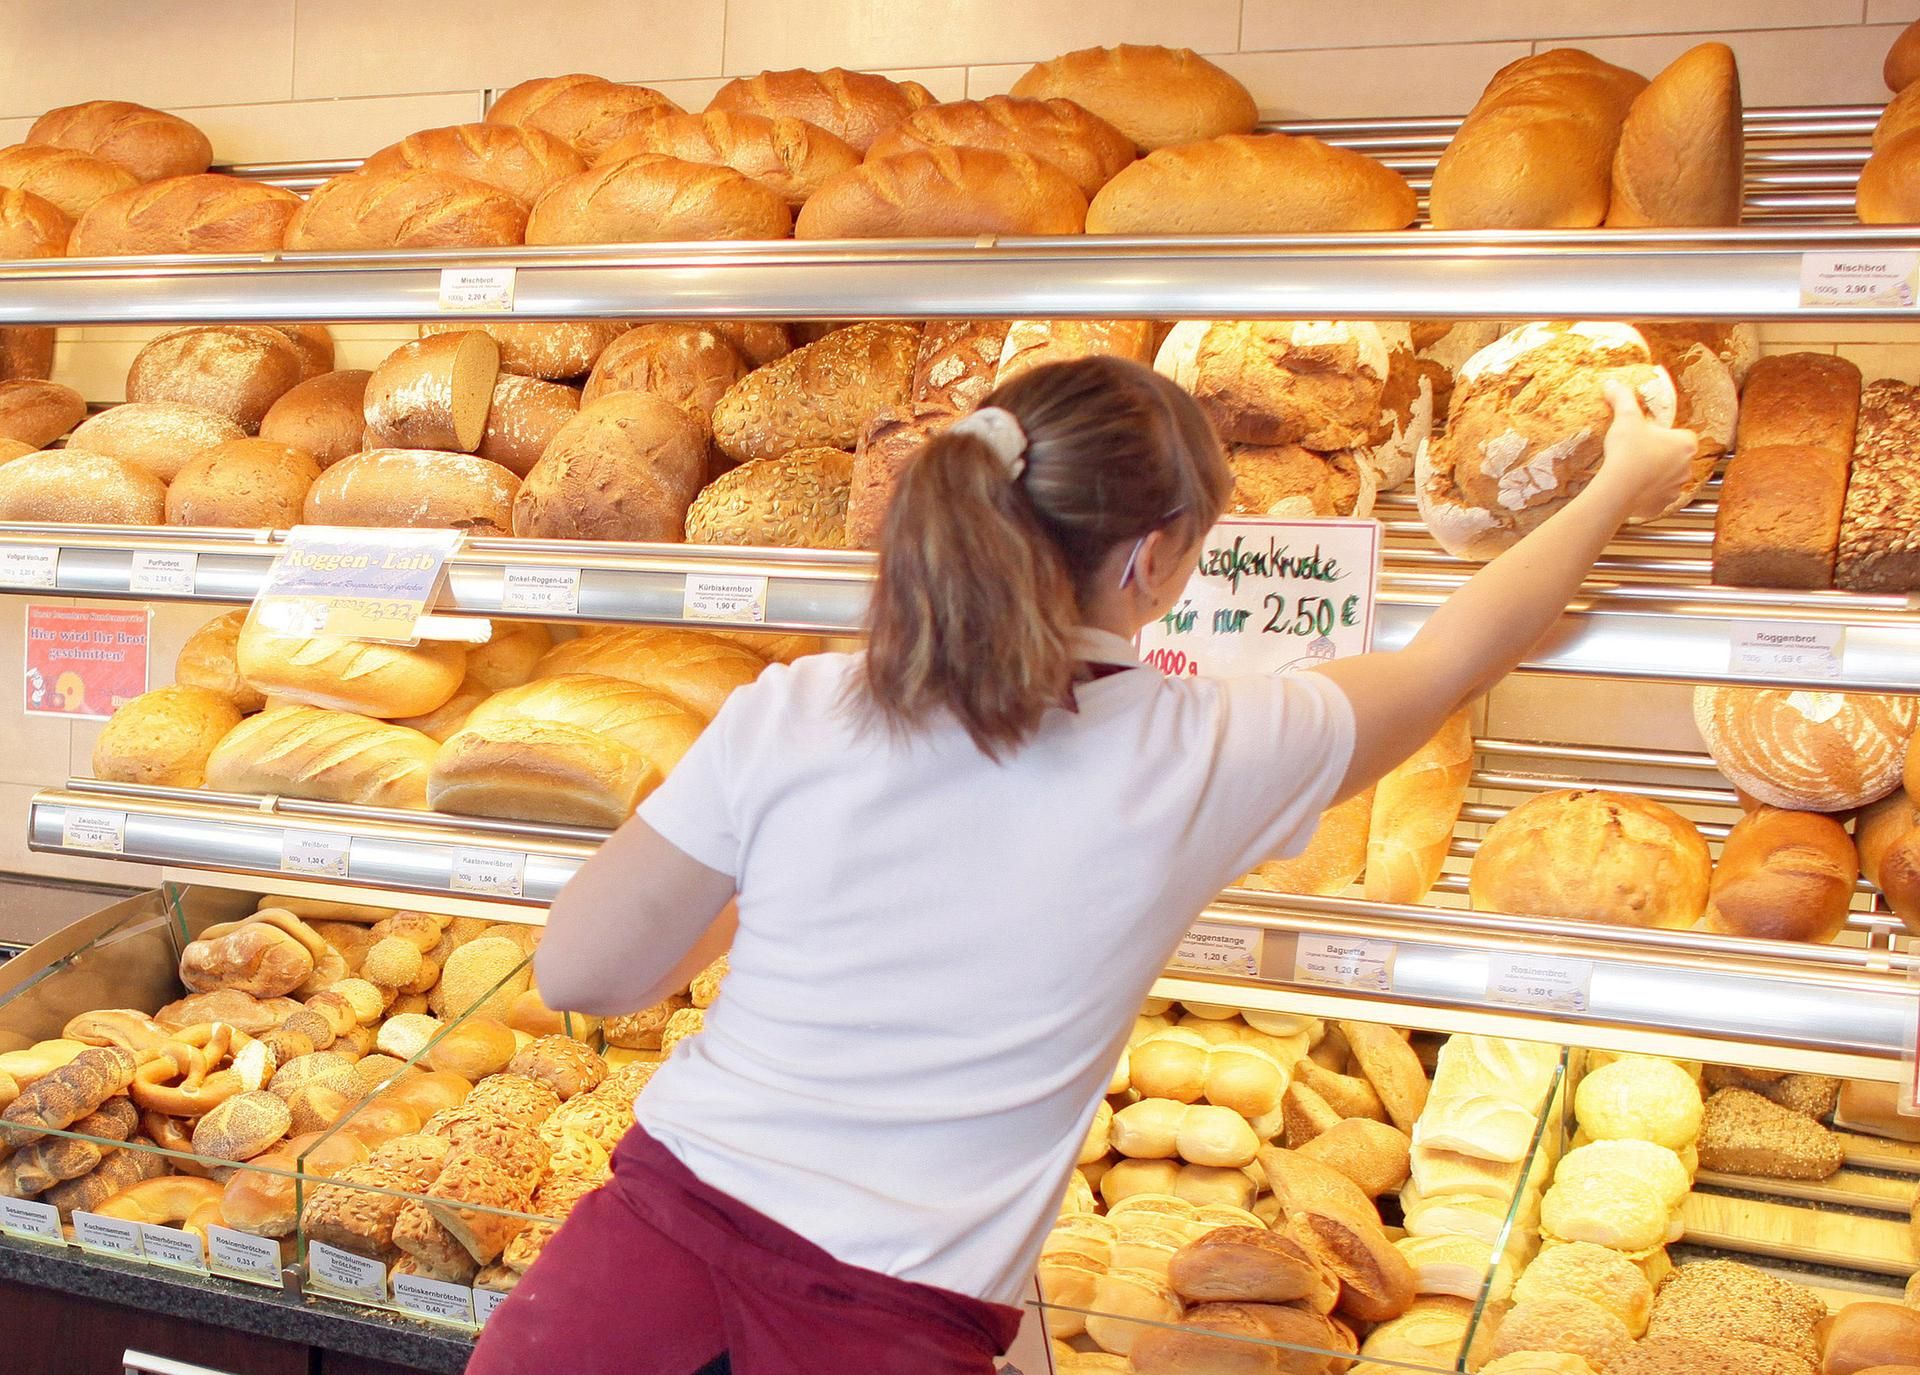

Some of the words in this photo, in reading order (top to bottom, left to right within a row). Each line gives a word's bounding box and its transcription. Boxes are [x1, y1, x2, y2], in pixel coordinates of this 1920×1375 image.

[1833, 263, 1886, 272] Mischbrot
[1814, 286, 1838, 295] 1500g
[1846, 285, 1866, 294] 2,90
[1869, 285, 1877, 294] €
[467, 293, 481, 301] 2,20
[285, 549, 368, 571] Roggen
[381, 552, 435, 571] Laib
[508, 575, 574, 585] Dinkel-Roggen-Laib
[698, 583, 752, 593] Kürbiskernbrot
[716, 602, 730, 610] 1,90
[1212, 608, 1254, 636] nur
[1341, 594, 1360, 627] €
[31, 628, 55, 640] Hier
[60, 631, 89, 642] wird
[94, 631, 113, 643] Ihr
[117, 632, 145, 645] Brot
[1756, 632, 1816, 643] Roggenbrot
[48, 647, 126, 662] geschnitten!
[1796, 655, 1803, 664] €
[302, 841, 329, 849] Weißbrot
[462, 857, 513, 868] Kastenweißbrot
[1184, 931, 1245, 945] Roggenstange
[1326, 945, 1366, 957] Baguette
[1203, 952, 1220, 961] 1,20
[1222, 954, 1228, 962] €
[1334, 965, 1352, 974] 1,20
[1353, 967, 1360, 976] €
[1511, 965, 1568, 978] Rosinenbrot
[1527, 987, 1545, 996] 1,50
[1547, 989, 1553, 997] €
[216, 1236, 271, 1256] Rosinenbrötchen
[320, 1246, 373, 1269] Sonnenblumen-
[331, 1258, 362, 1273] brötchen
[398, 1283, 467, 1303] Kürbiskernbrötchen
